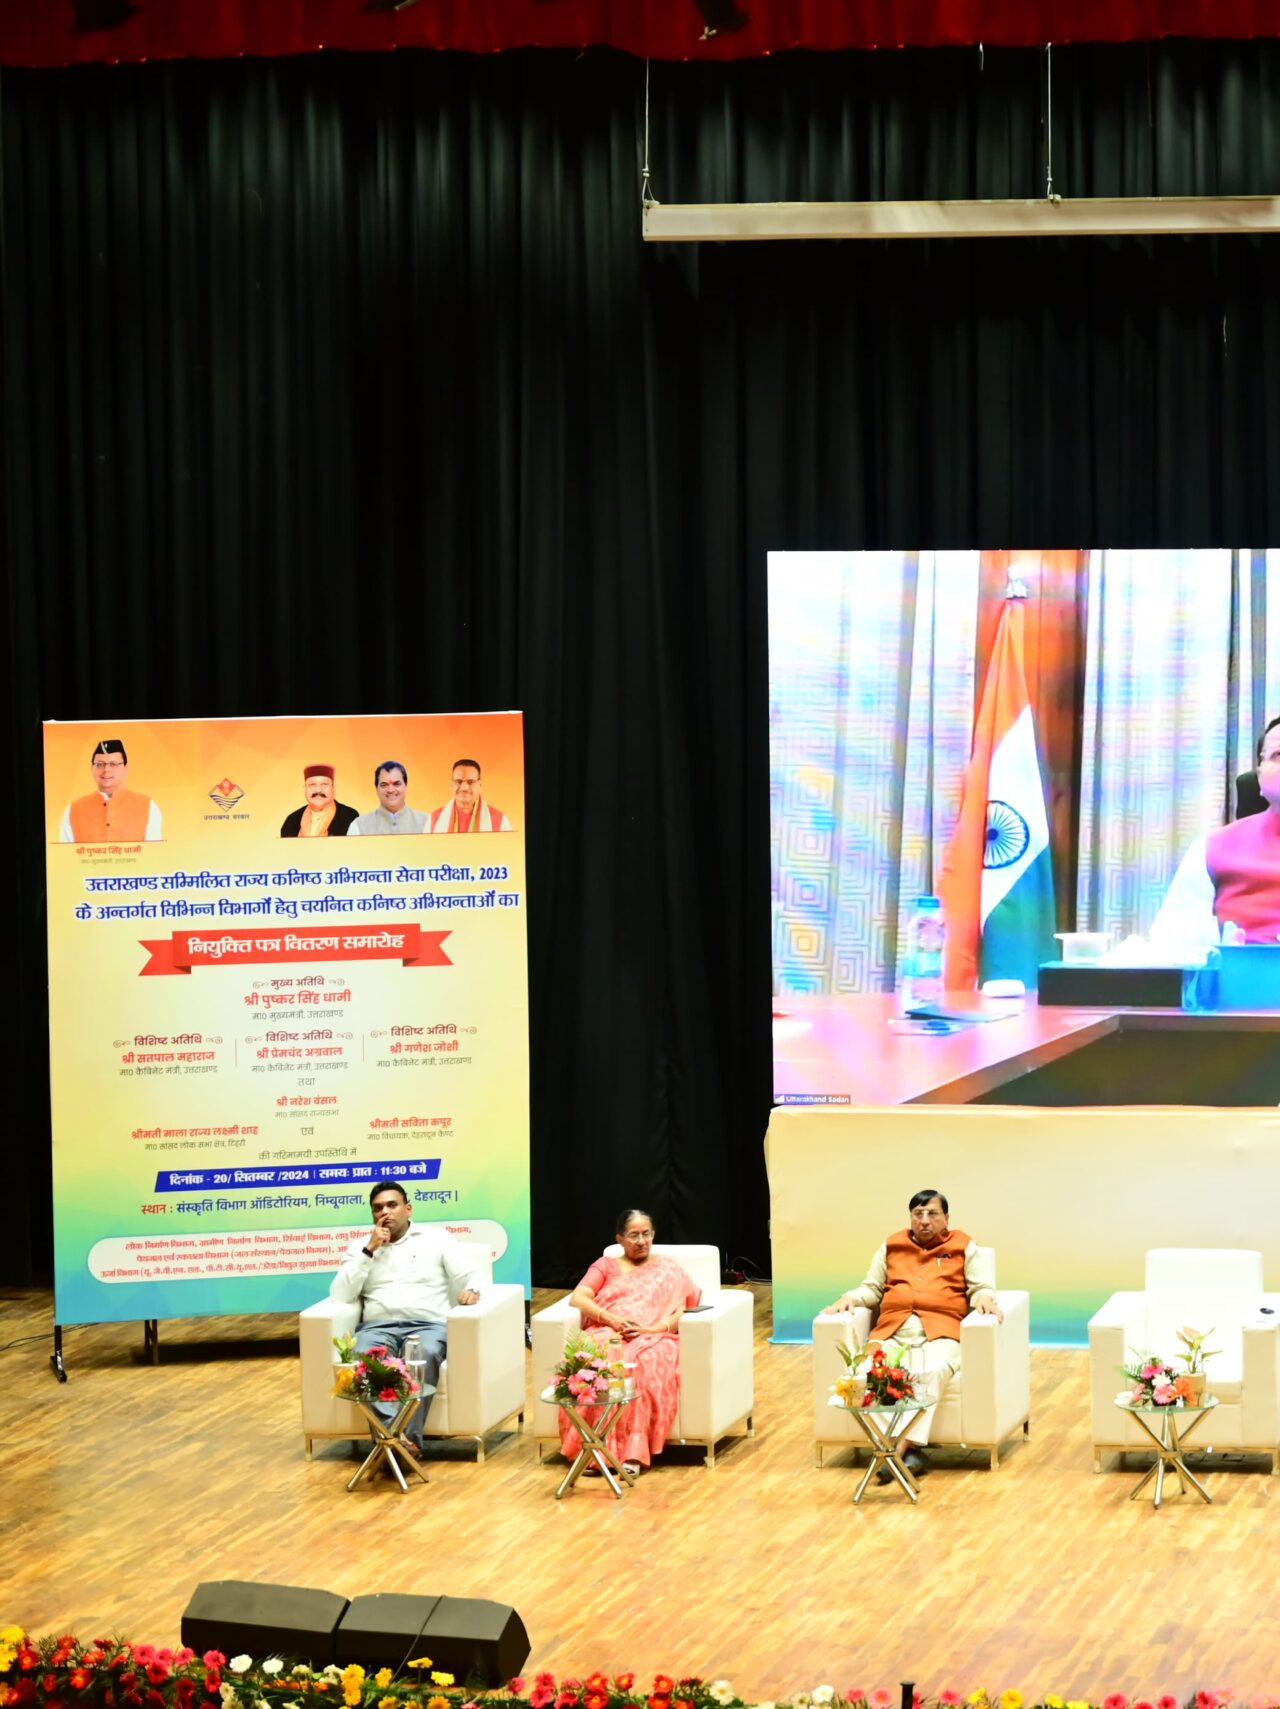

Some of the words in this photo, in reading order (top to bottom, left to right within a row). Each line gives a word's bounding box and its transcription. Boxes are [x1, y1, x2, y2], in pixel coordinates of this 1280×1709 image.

[86, 877, 158, 891] उत्तराखण्ड
[161, 872, 230, 889] सम्मिलित
[234, 874, 268, 886] राज्य
[272, 869, 322, 885] कनिष्ठ
[325, 867, 392, 884] अभियन्ता
[396, 867, 425, 882] सेवा
[428, 864, 475, 882] परीक्षा,
[479, 867, 508, 879] 2023
[75, 903, 92, 919] के
[96, 901, 156, 919] अन्तर्गत
[160, 900, 214, 917] विभिन्न
[218, 897, 271, 916] विभागों
[275, 898, 298, 918] हेतु
[301, 895, 353, 913] चयनित
[357, 894, 406, 911] कनिष्ठ
[410, 890, 495, 910] अभियन्ताओं
[498, 894, 519, 906] का
[188, 936, 251, 958] नियुक्ति
[255, 939, 280, 951] पत्र
[284, 934, 339, 951] वितरण
[343, 932, 404, 948] समारोह
[271, 978, 292, 989] मुख्य
[296, 976, 324, 986] अतिथि
[244, 992, 258, 1006] श्री
[262, 993, 295, 1008] पुष्कर
[298, 990, 319, 1004] सिंह
[323, 989, 351, 1003] धामी
[308, 1010, 343, 1019] उत्तराखण्ड
[266, 1032, 299, 1042] विशिष्ट
[303, 1030, 332, 1041] अतिथि
[391, 1026, 424, 1037] विशिष्ट
[427, 1024, 456, 1035] अतिथि
[134, 1036, 168, 1046] विशिष्ट
[171, 1034, 202, 1044] अतिथि
[257, 1047, 269, 1059] श्री
[271, 1047, 302, 1058] प्रेमचंद
[305, 1047, 342, 1056] अग्रवाल
[390, 1042, 401, 1054] श्री
[404, 1043, 431, 1053] गणेश
[434, 1040, 459, 1052] जोशी
[122, 1052, 134, 1063] श्री
[138, 1053, 174, 1062] सतपाल
[177, 1051, 215, 1061] महाराज
[298, 1078, 315, 1087] तथा
[277, 1096, 287, 1106] श्री
[290, 1097, 311, 1105] नरेश
[370, 1118, 399, 1128] श्रीमती
[401, 1117, 428, 1128] सविता
[431, 1117, 451, 1128] कपूर
[131, 1128, 161, 1139] श्रीमती
[164, 1129, 187, 1137] माला
[190, 1128, 210, 1136] राज्य
[213, 1125, 238, 1136] लक्ष्मी
[241, 1126, 258, 1135] शाह
[301, 1127, 314, 1136] एवं
[259, 1152, 270, 1160] की
[170, 1174, 203, 1185] दिनांक
[214, 1174, 231, 1184] 20/
[234, 1171, 275, 1182] सितम्बर
[278, 1171, 309, 1181] /2024
[353, 1168, 371, 1177] प्रात
[381, 1166, 406, 1175] 11:30
[409, 1162, 427, 1174] बजे
[142, 1204, 166, 1214] स्थान
[177, 1199, 212, 1216] संस्कृति
[217, 1199, 246, 1210] विभाग
[250, 1196, 311, 1208] ऑडिटोरियम,
[315, 1194, 365, 1209] निम्बूवाला,
[415, 1190, 451, 1204] देहरादून
